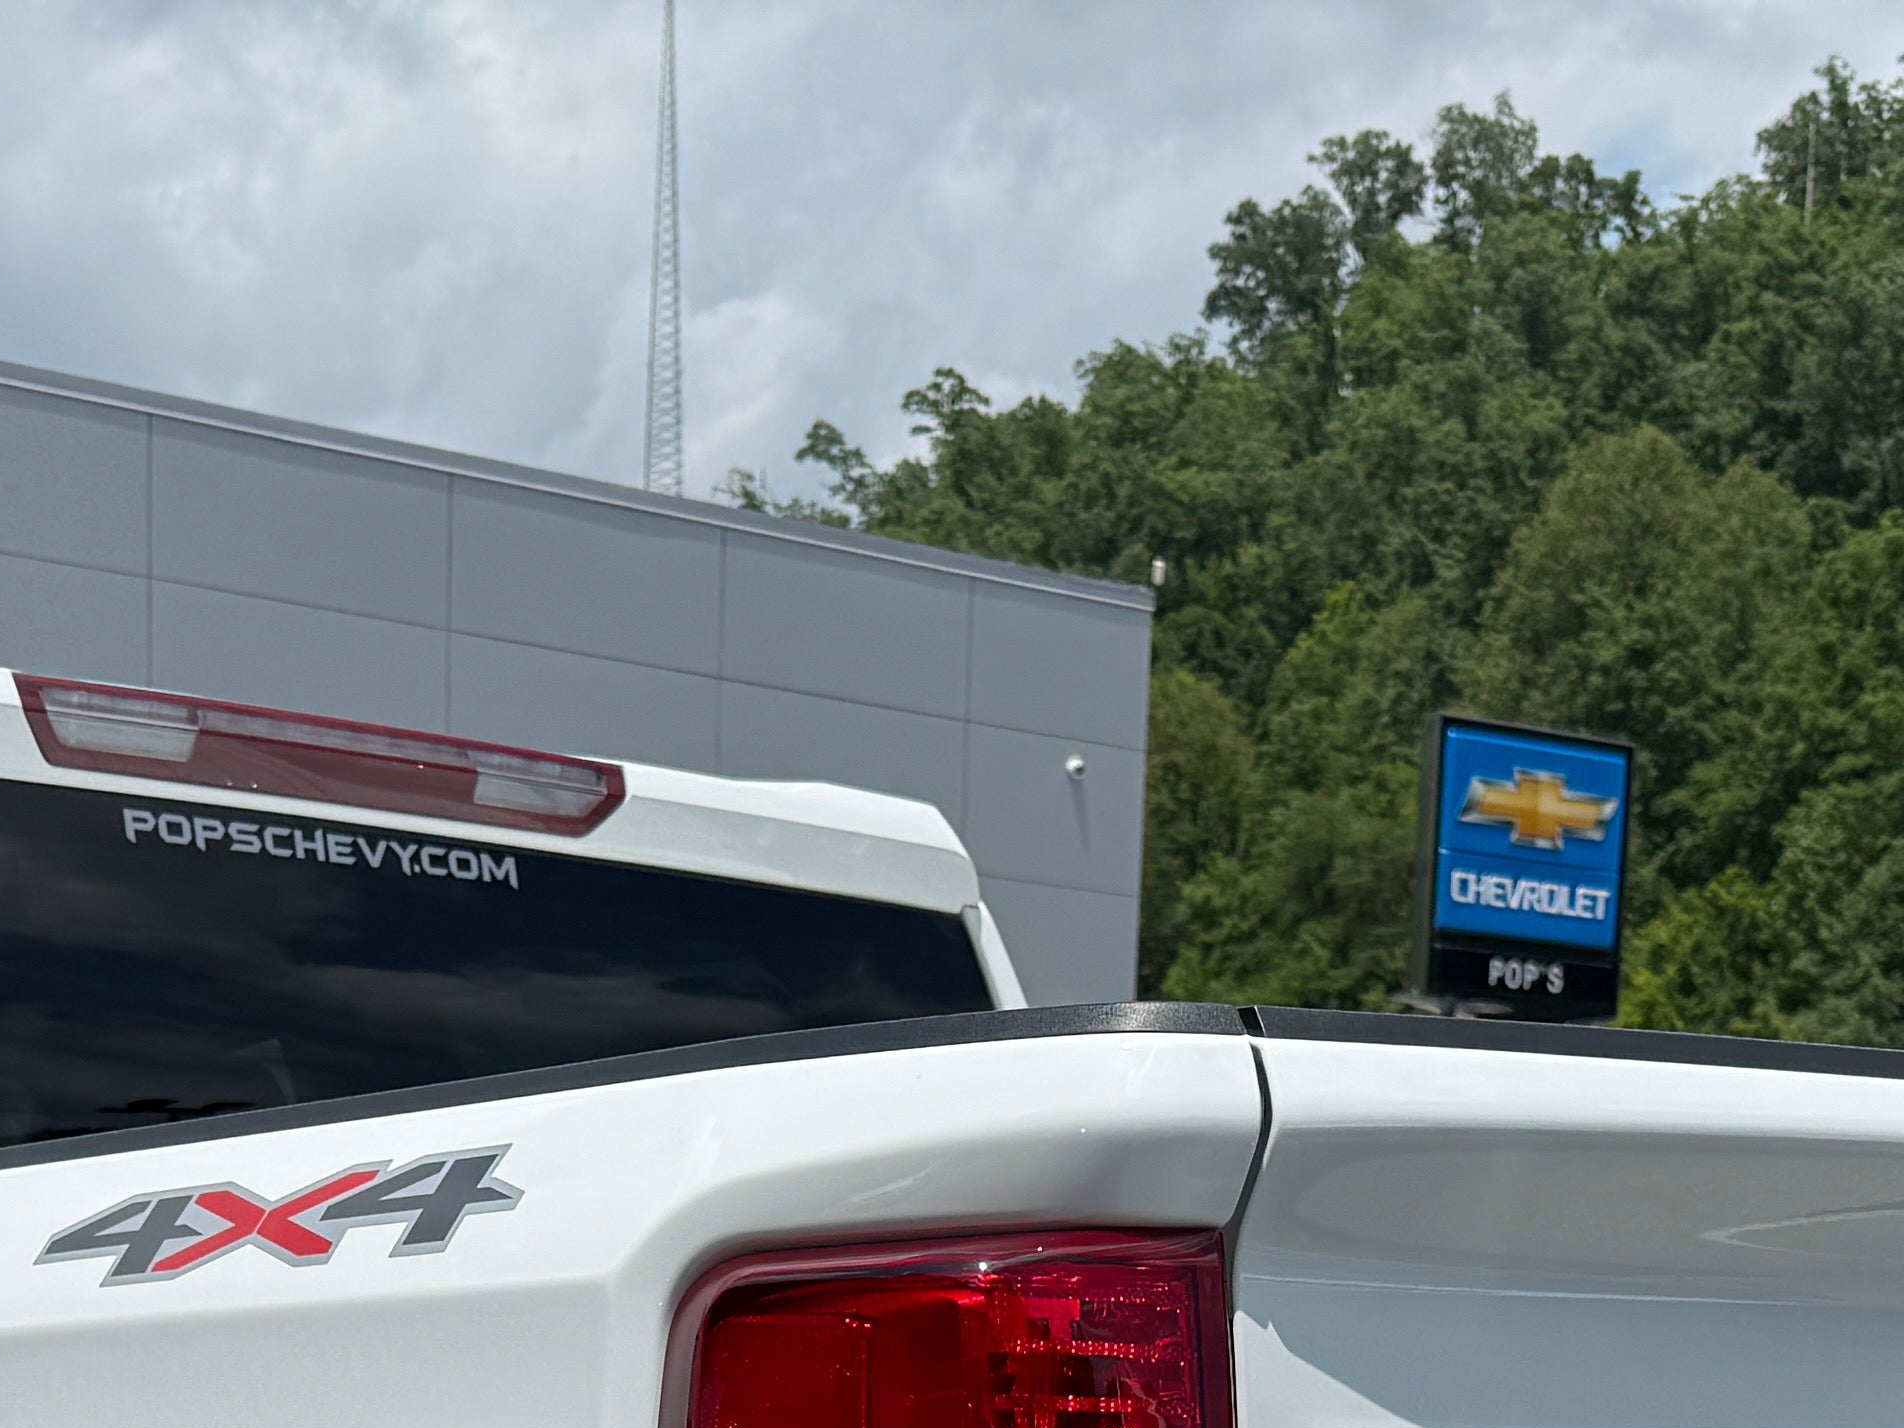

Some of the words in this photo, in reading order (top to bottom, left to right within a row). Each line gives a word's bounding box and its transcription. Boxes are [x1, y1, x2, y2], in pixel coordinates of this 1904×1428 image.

[122, 807, 520, 891] POPSCHEVY.COM
[1450, 868, 1611, 921] CHEVROLET
[1487, 955, 1566, 995] POP'S
